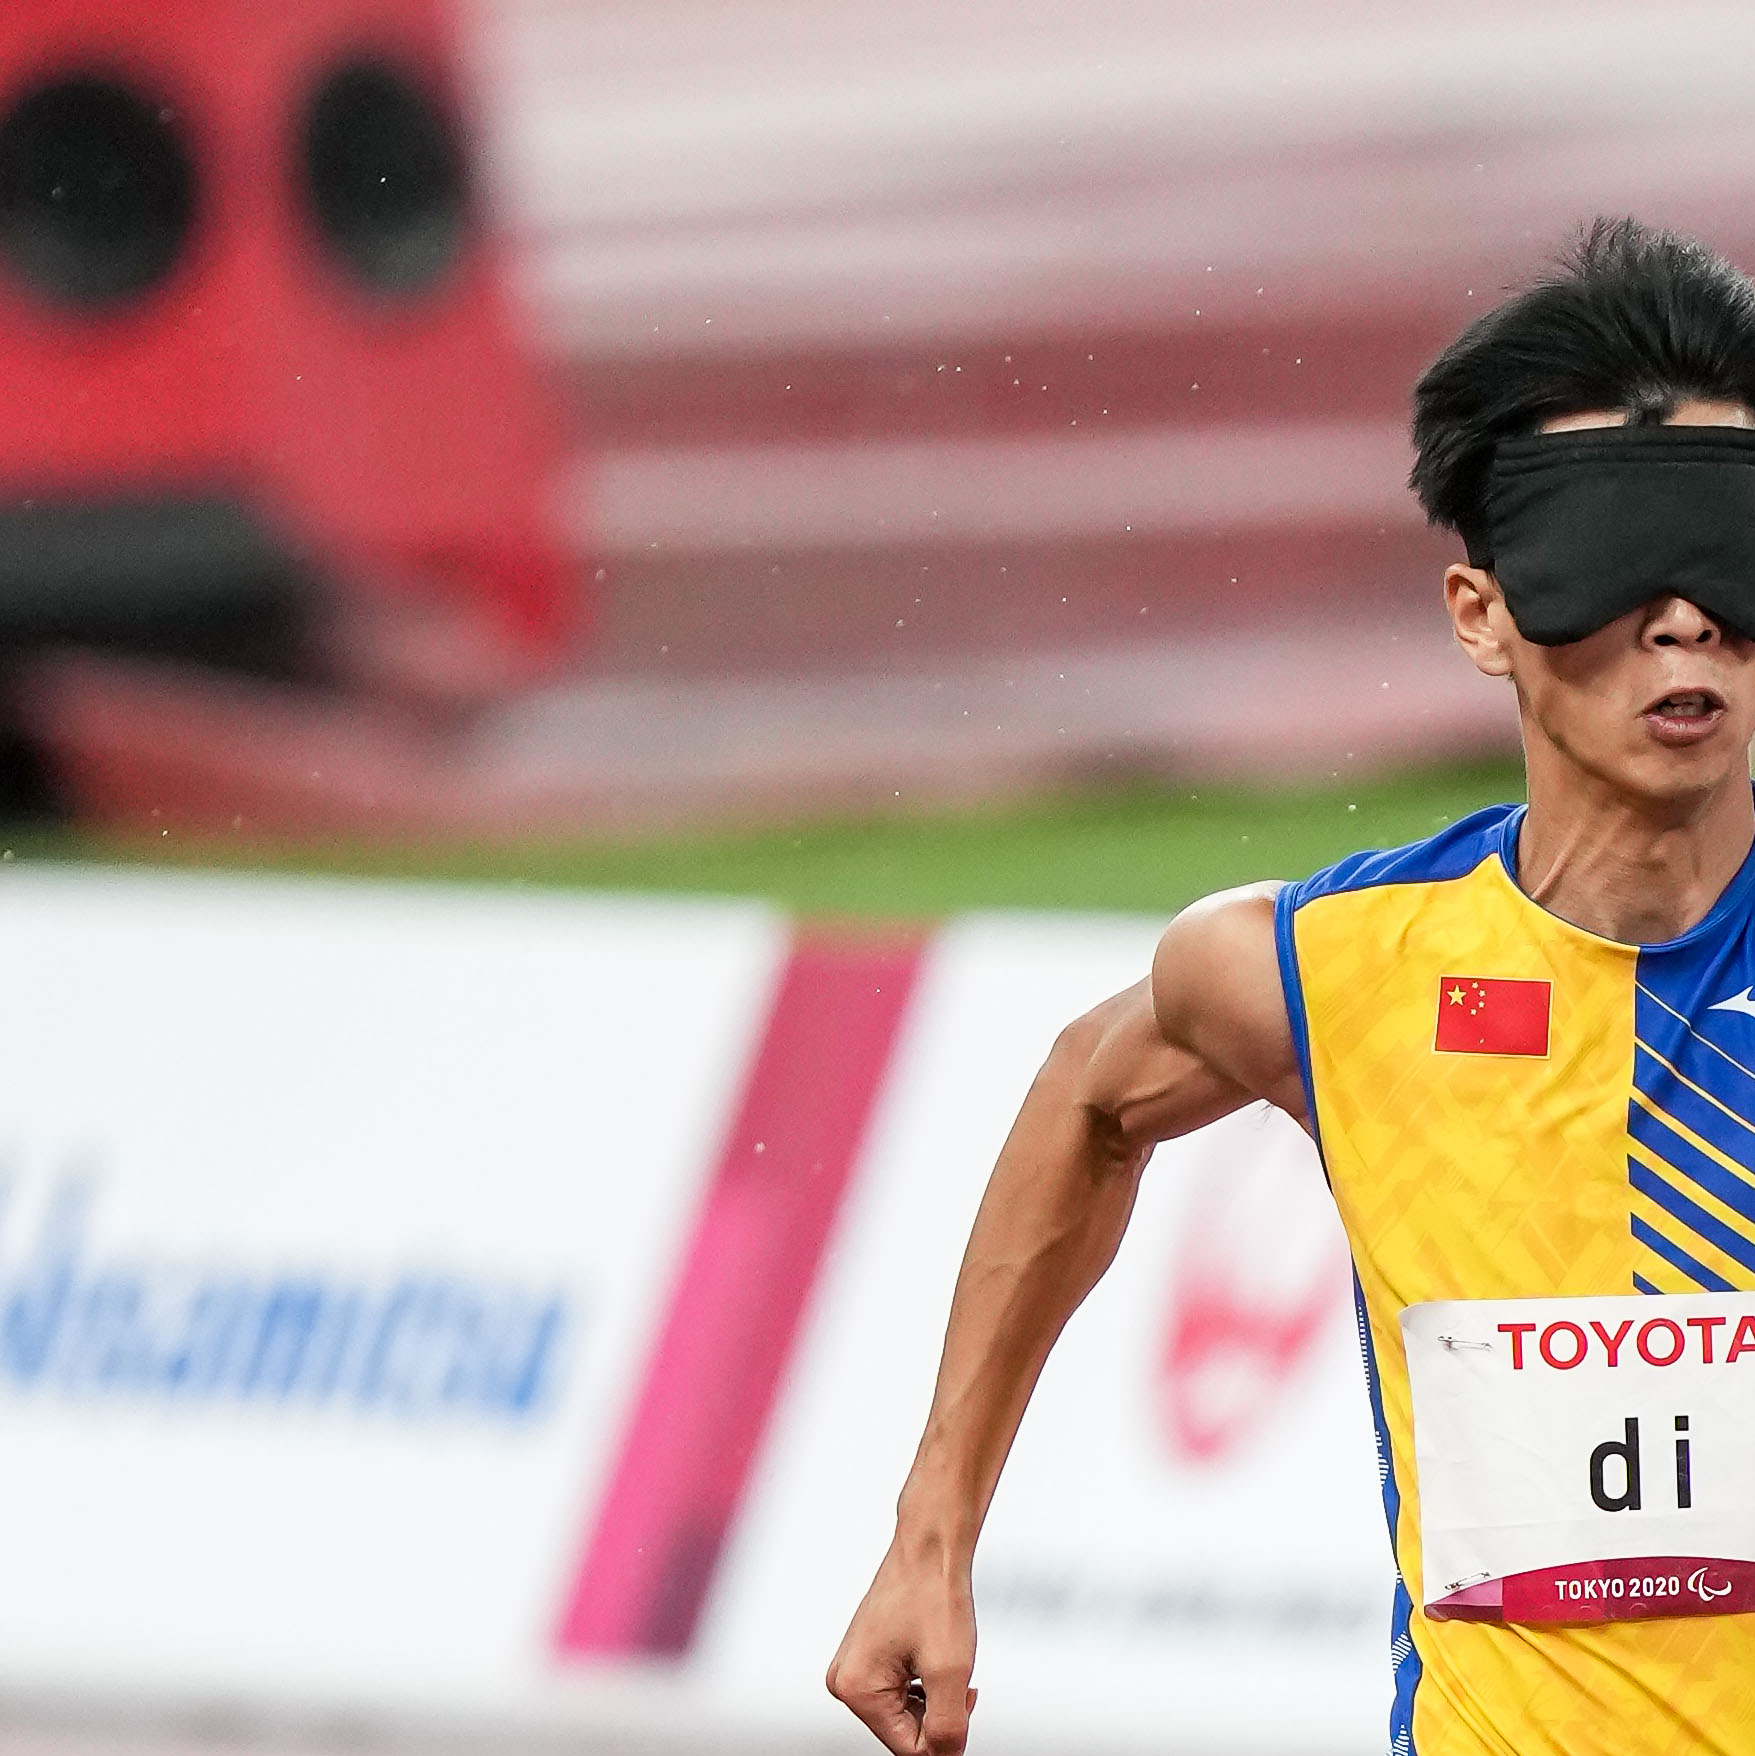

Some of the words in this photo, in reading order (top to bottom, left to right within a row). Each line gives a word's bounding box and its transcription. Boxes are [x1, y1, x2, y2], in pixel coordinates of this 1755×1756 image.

[1588, 1414, 1693, 1513] di
[1554, 1578, 1625, 1601] TOKYO
[1628, 1575, 1681, 1598] 2020
